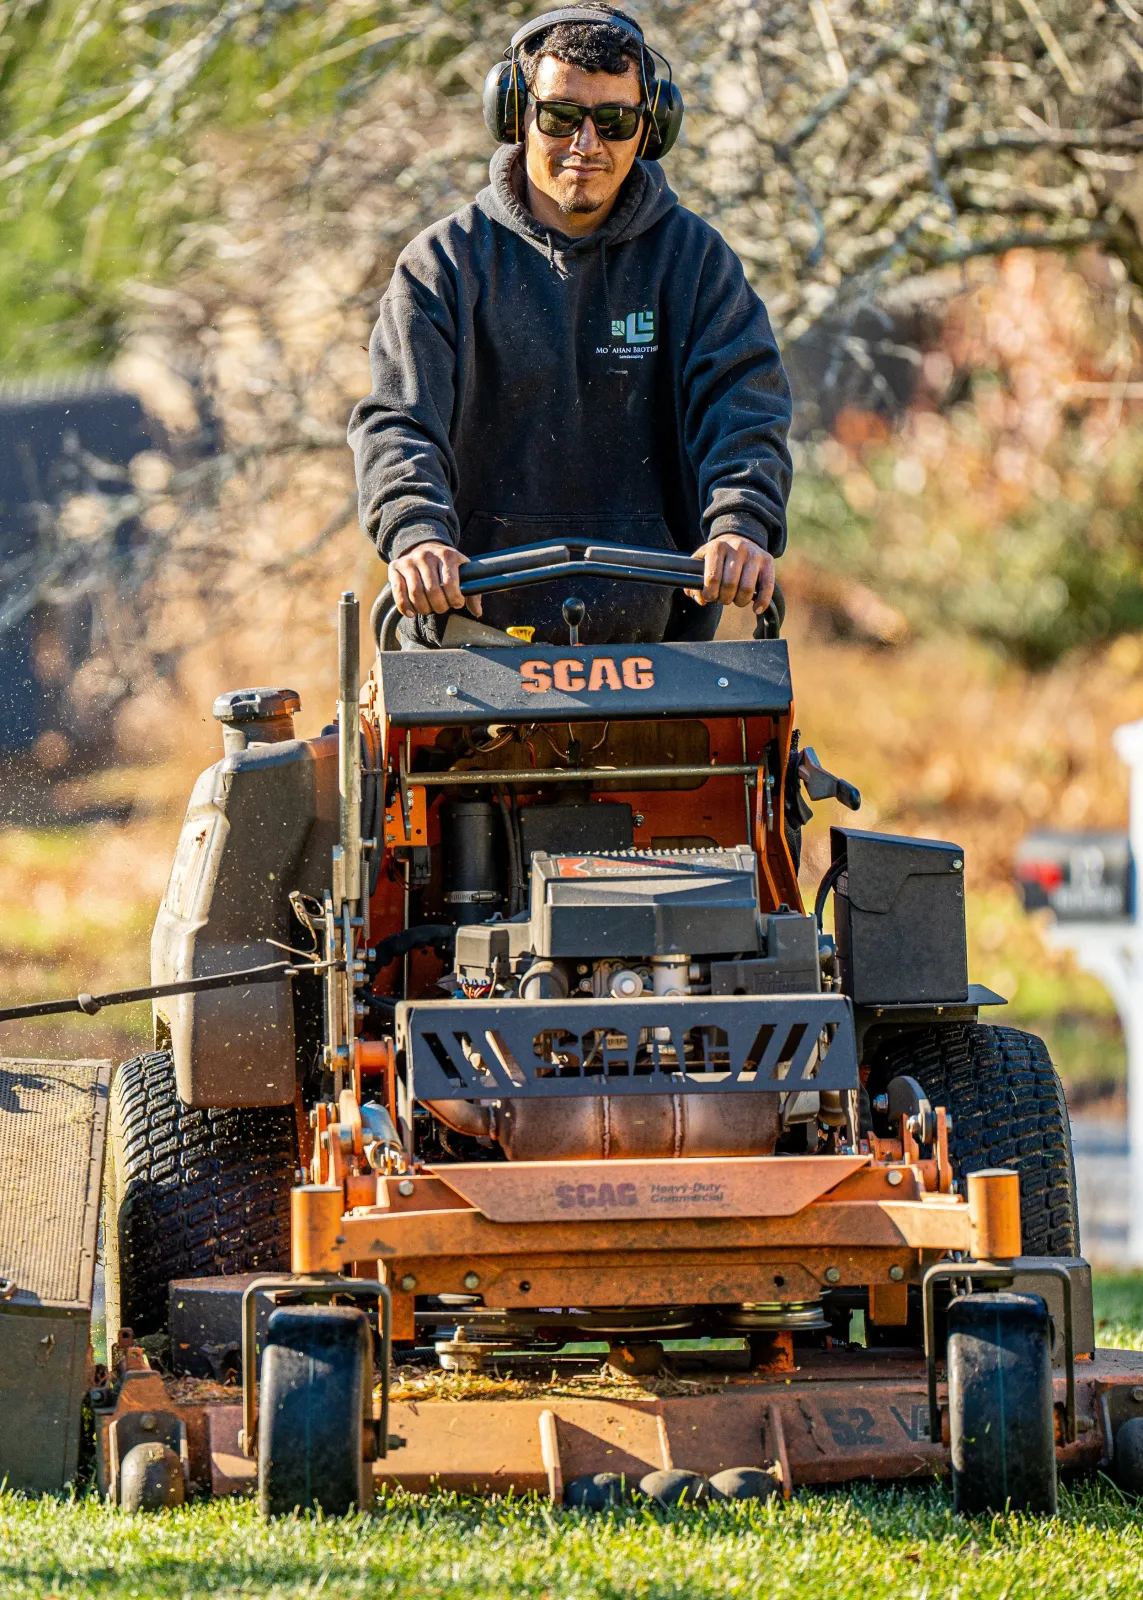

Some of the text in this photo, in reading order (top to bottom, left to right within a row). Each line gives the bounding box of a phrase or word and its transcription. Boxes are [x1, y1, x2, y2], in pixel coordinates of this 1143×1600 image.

[595, 346, 632, 354] MOAHAN
[520, 656, 656, 694] SCAG
[532, 1025, 733, 1083] SCAG
[555, 1182, 638, 1209] SCAG
[650, 1192, 724, 1204] Commercial
[821, 1406, 885, 1447] 52
